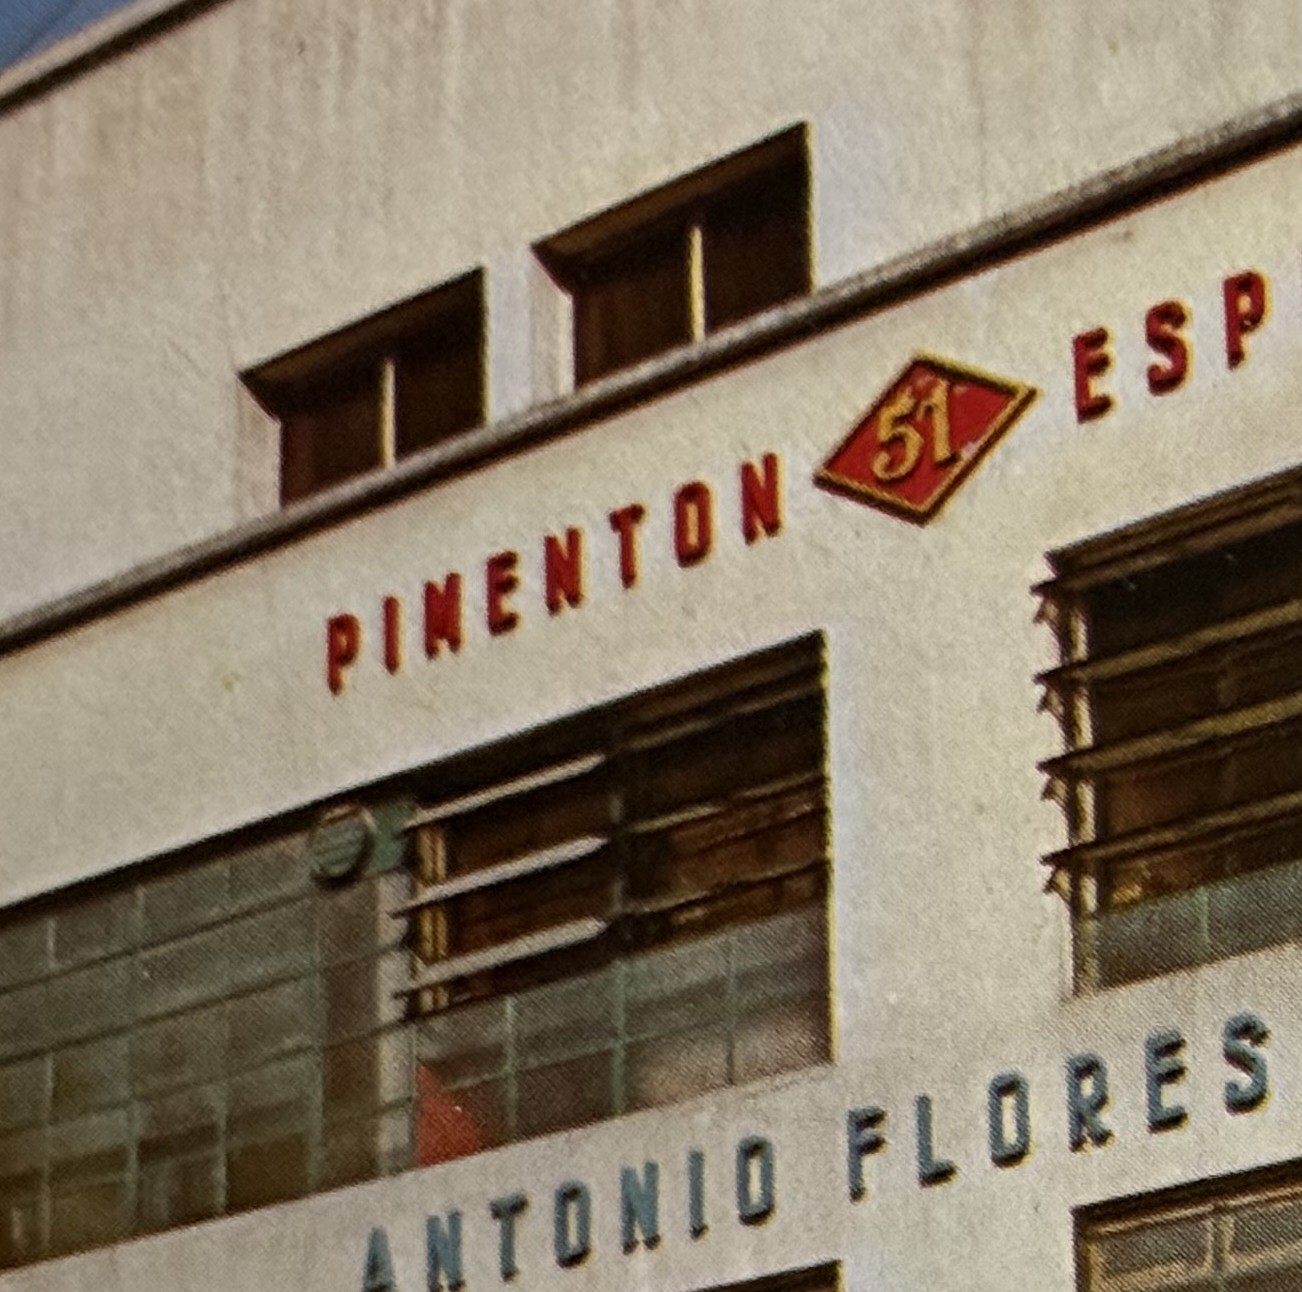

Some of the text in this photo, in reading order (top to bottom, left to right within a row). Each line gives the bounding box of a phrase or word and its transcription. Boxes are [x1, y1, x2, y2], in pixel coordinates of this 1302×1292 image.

[326, 452, 783, 697] PIMENTON
[871, 378, 962, 484] 51
[847, 1010, 1272, 1203] FLORES
